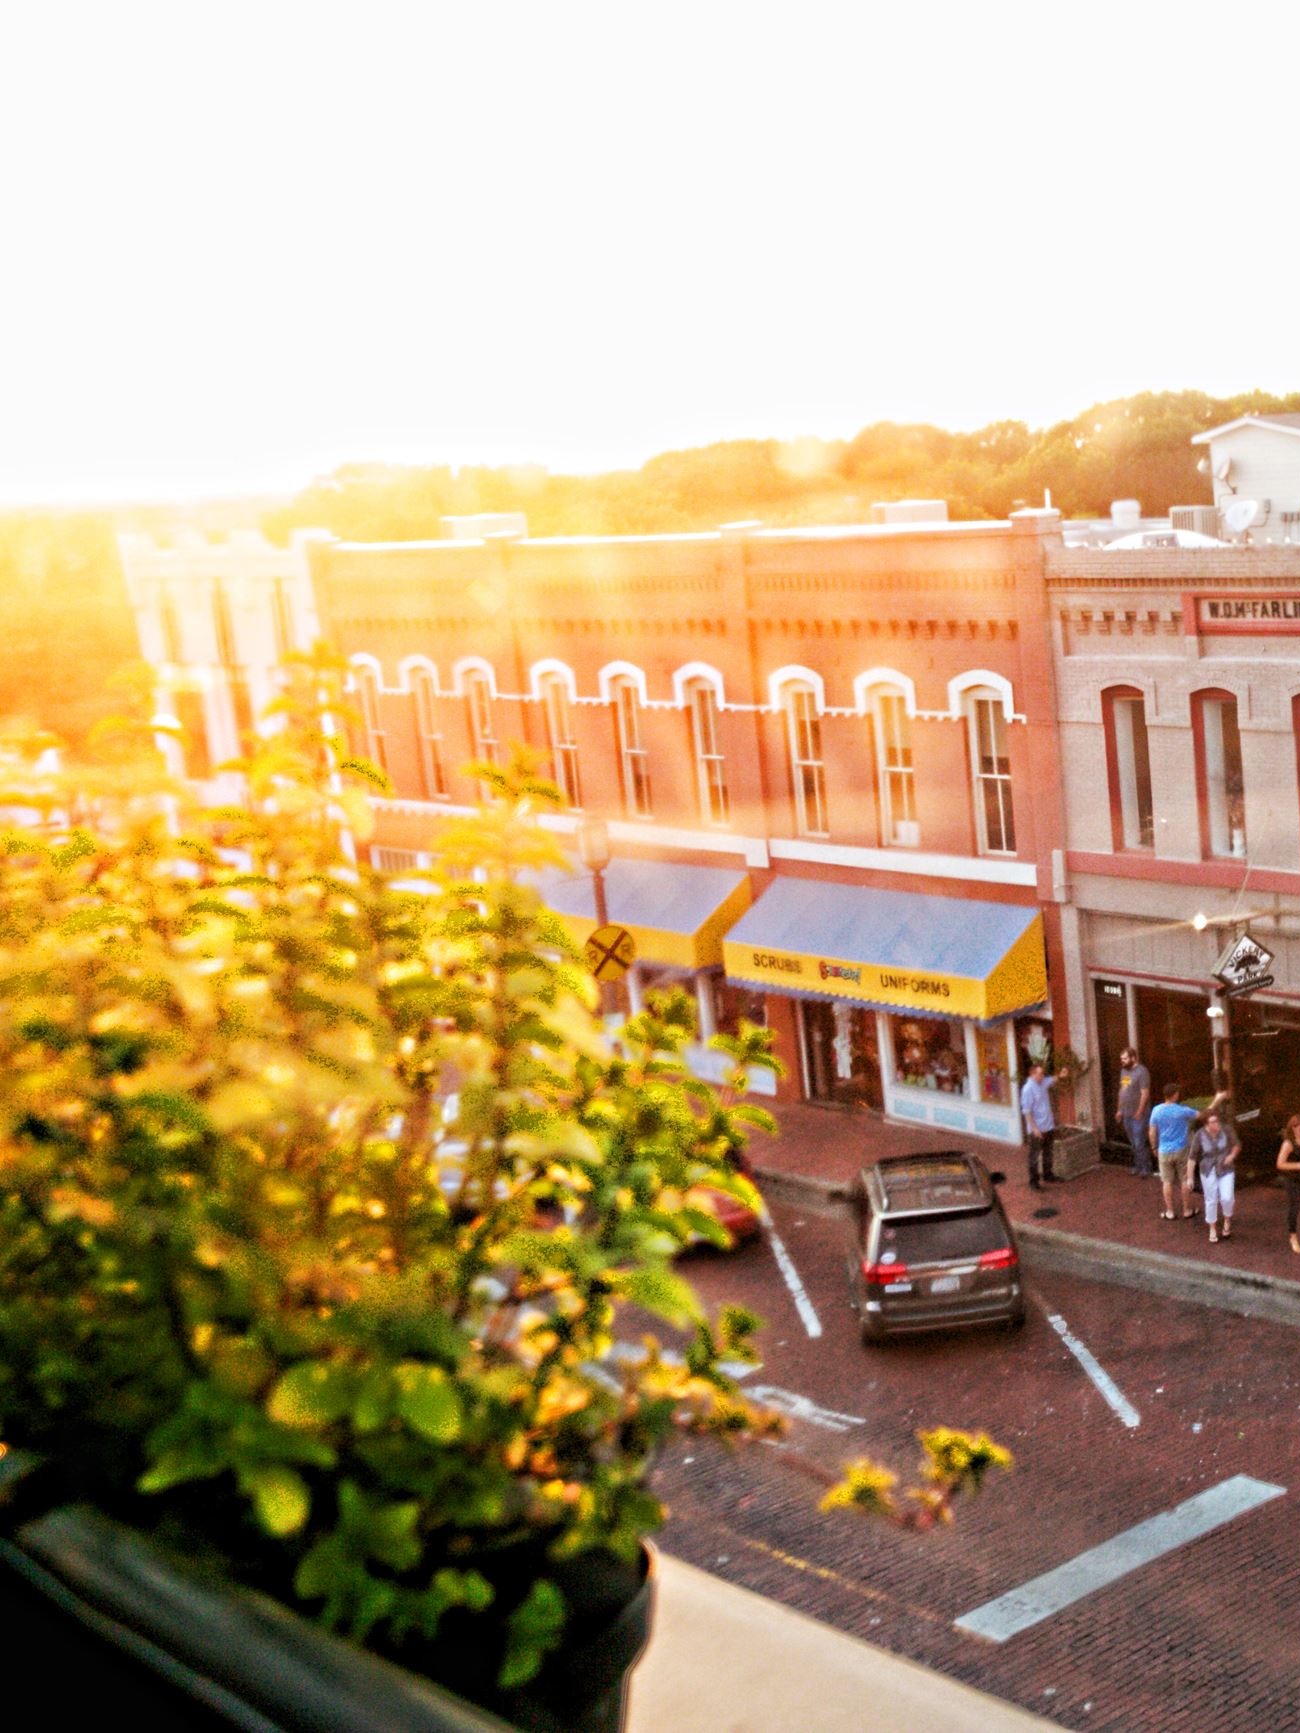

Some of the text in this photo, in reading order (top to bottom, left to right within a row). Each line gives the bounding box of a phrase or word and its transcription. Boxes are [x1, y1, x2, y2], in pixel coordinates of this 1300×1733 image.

[1229, 946, 1265, 969] VICKERY
[752, 953, 802, 974] SCRUBS
[880, 974, 951, 998] UNIFORMS
